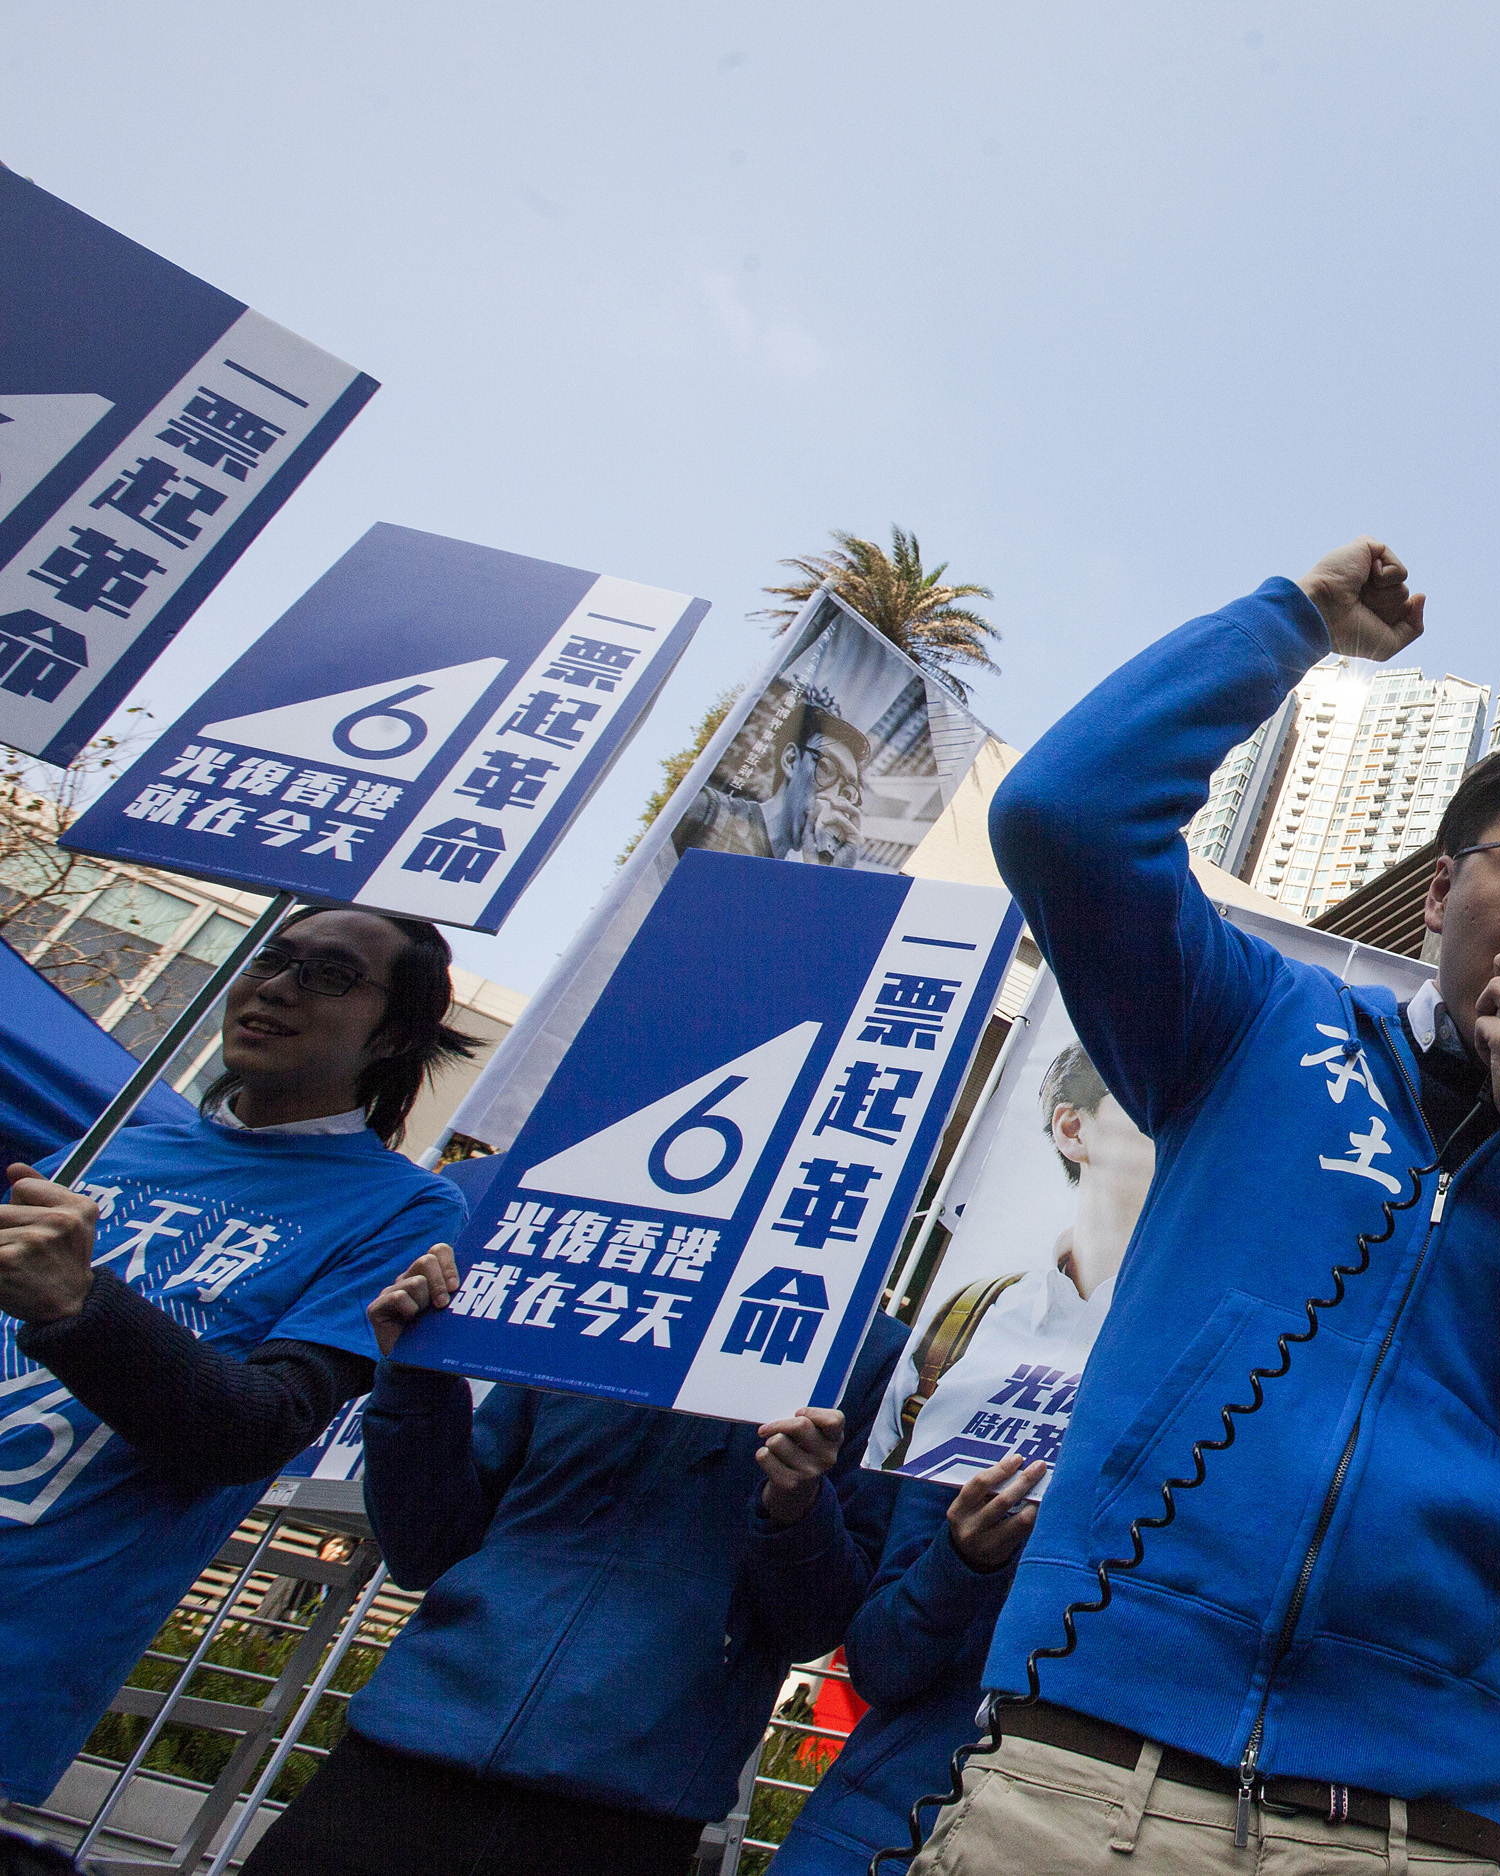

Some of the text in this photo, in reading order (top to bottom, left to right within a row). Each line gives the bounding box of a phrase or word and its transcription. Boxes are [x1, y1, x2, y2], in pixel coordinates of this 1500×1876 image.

[332, 684, 433, 760] 6
[401, 612, 657, 884] 一票起革命
[123, 784, 376, 861] 就在今天
[160, 744, 404, 824] 光復香港
[647, 1075, 744, 1195] 6
[721, 934, 977, 1365] 一票起革命
[483, 1202, 722, 1282] 光復香港
[450, 1261, 692, 1348] 就在今天
